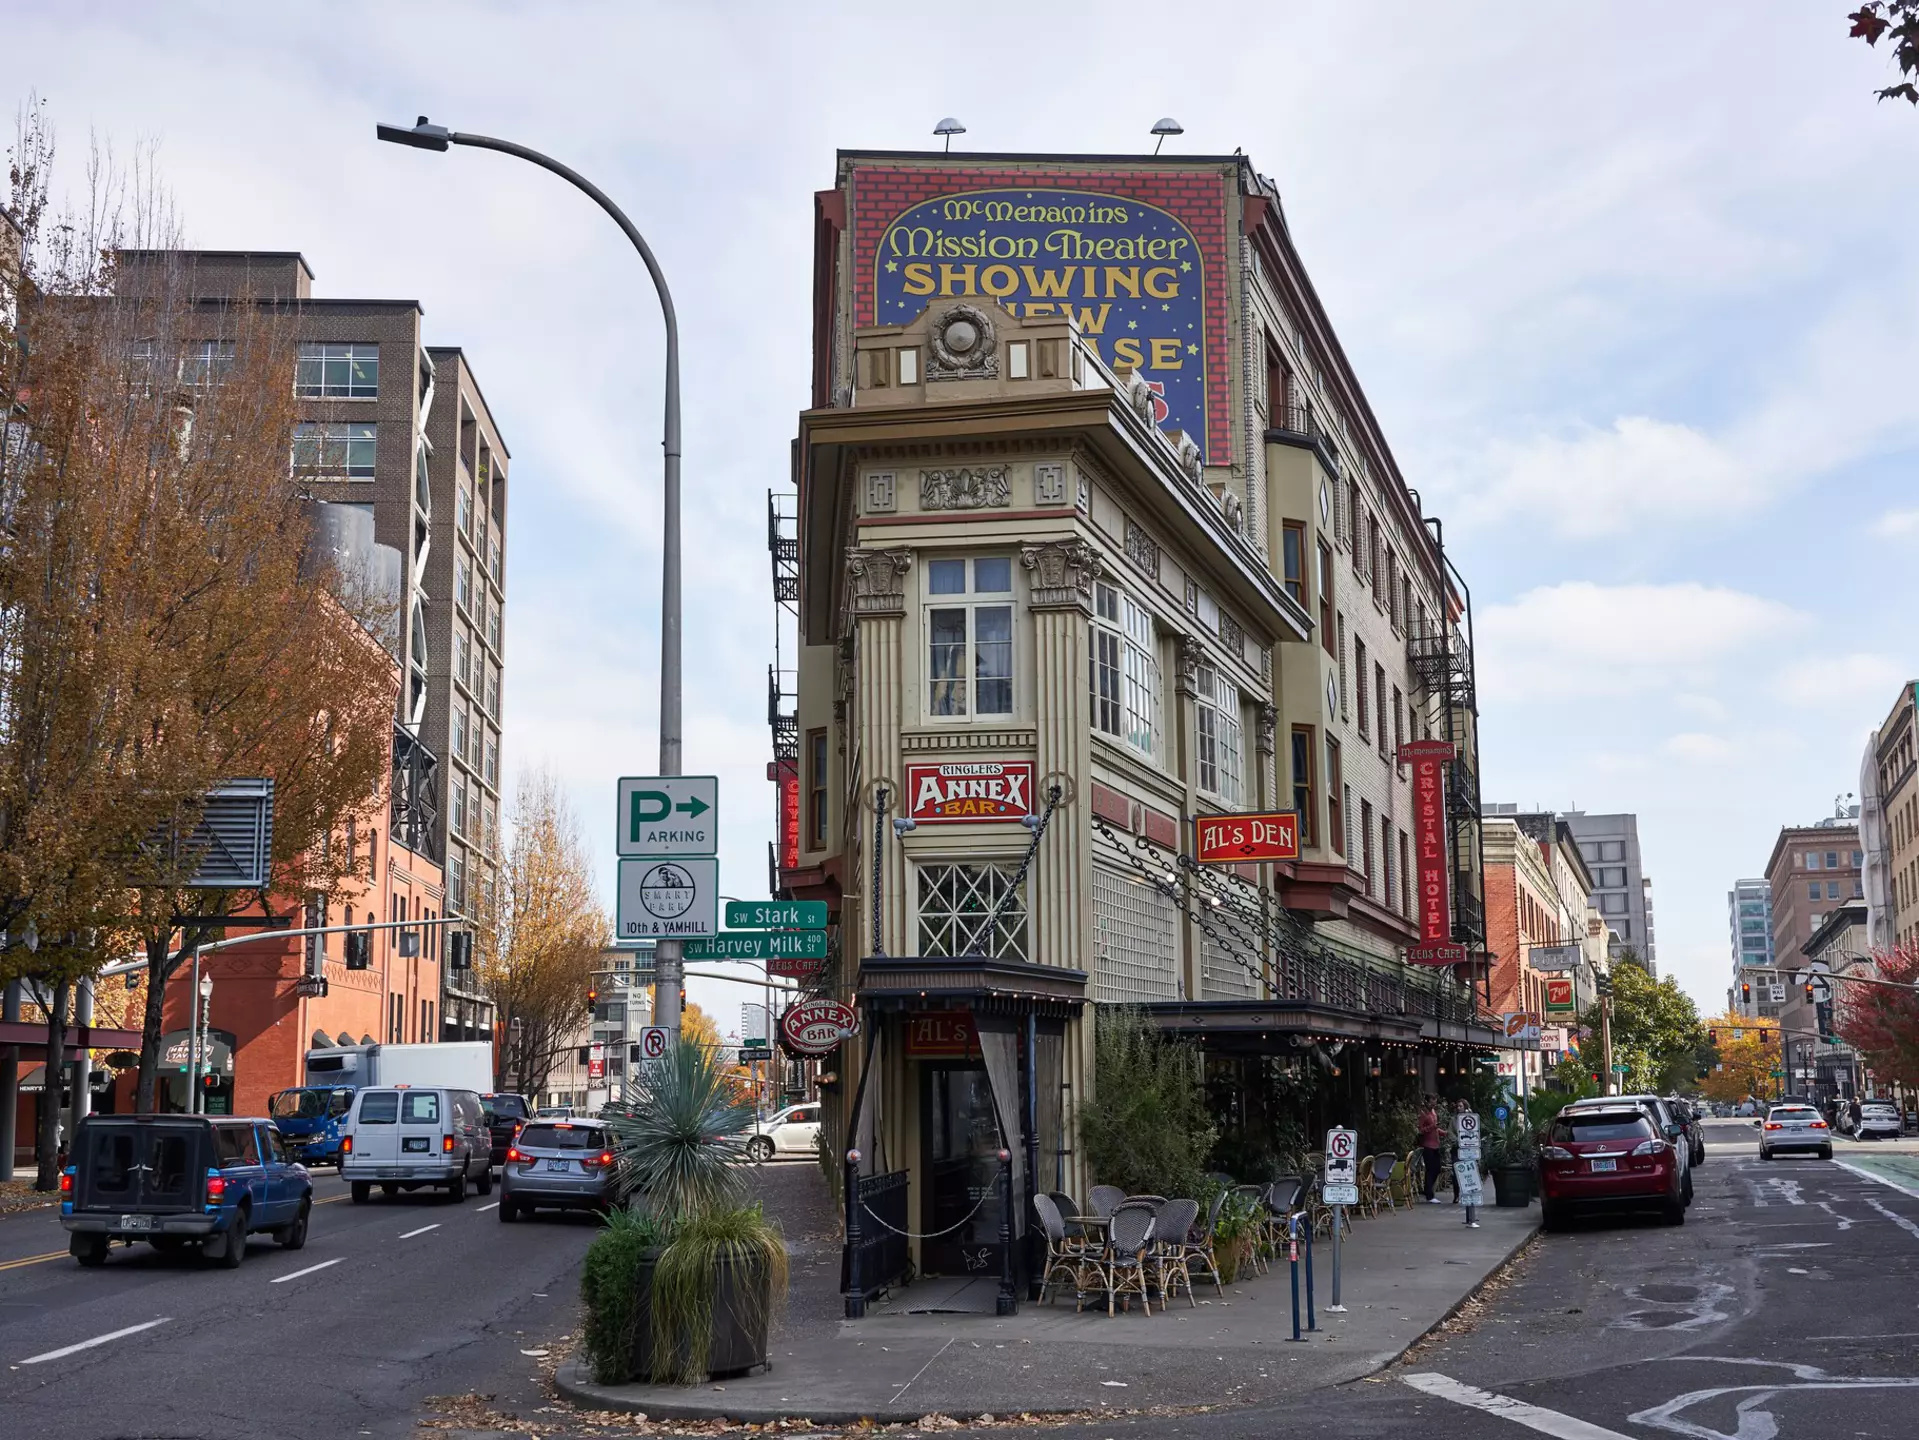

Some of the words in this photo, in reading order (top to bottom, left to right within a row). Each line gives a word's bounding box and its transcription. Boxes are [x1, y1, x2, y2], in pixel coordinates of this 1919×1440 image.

[944, 199, 1129, 224] McMenamins
[889, 226, 1039, 259] Mission
[1045, 229, 1188, 261] Theater
[903, 262, 1181, 299] SHOWING
[942, 764, 1001, 775] RINGLERS
[913, 775, 1027, 812] ANNEX
[944, 800, 996, 814] BAR
[1420, 762, 1437, 859] CRYSTAL
[629, 790, 705, 843] PARKING
[1203, 825, 1245, 852] AL'S
[1251, 820, 1293, 848] DEN
[644, 890, 691, 900] SMART
[1425, 869, 1441, 939] HOTEL
[650, 902, 684, 911] PARK
[734, 911, 748, 923] SW
[755, 908, 799, 923] Stark
[807, 913, 815, 923] St
[626, 922, 648, 933] 10th
[652, 921, 660, 933] &
[663, 921, 708, 933] YAMHILL
[688, 943, 703, 953] SW
[706, 938, 762, 957] Harvey
[769, 936, 803, 953] Milk
[807, 934, 822, 943] 400
[807, 943, 815, 952] St
[1410, 948, 1434, 960] ZEUS
[790, 1009, 851, 1032] ANNEX
[1531, 1014, 1537, 1024] 2
[807, 1028, 836, 1040] BAR
[917, 1018, 967, 1042] AL'S
